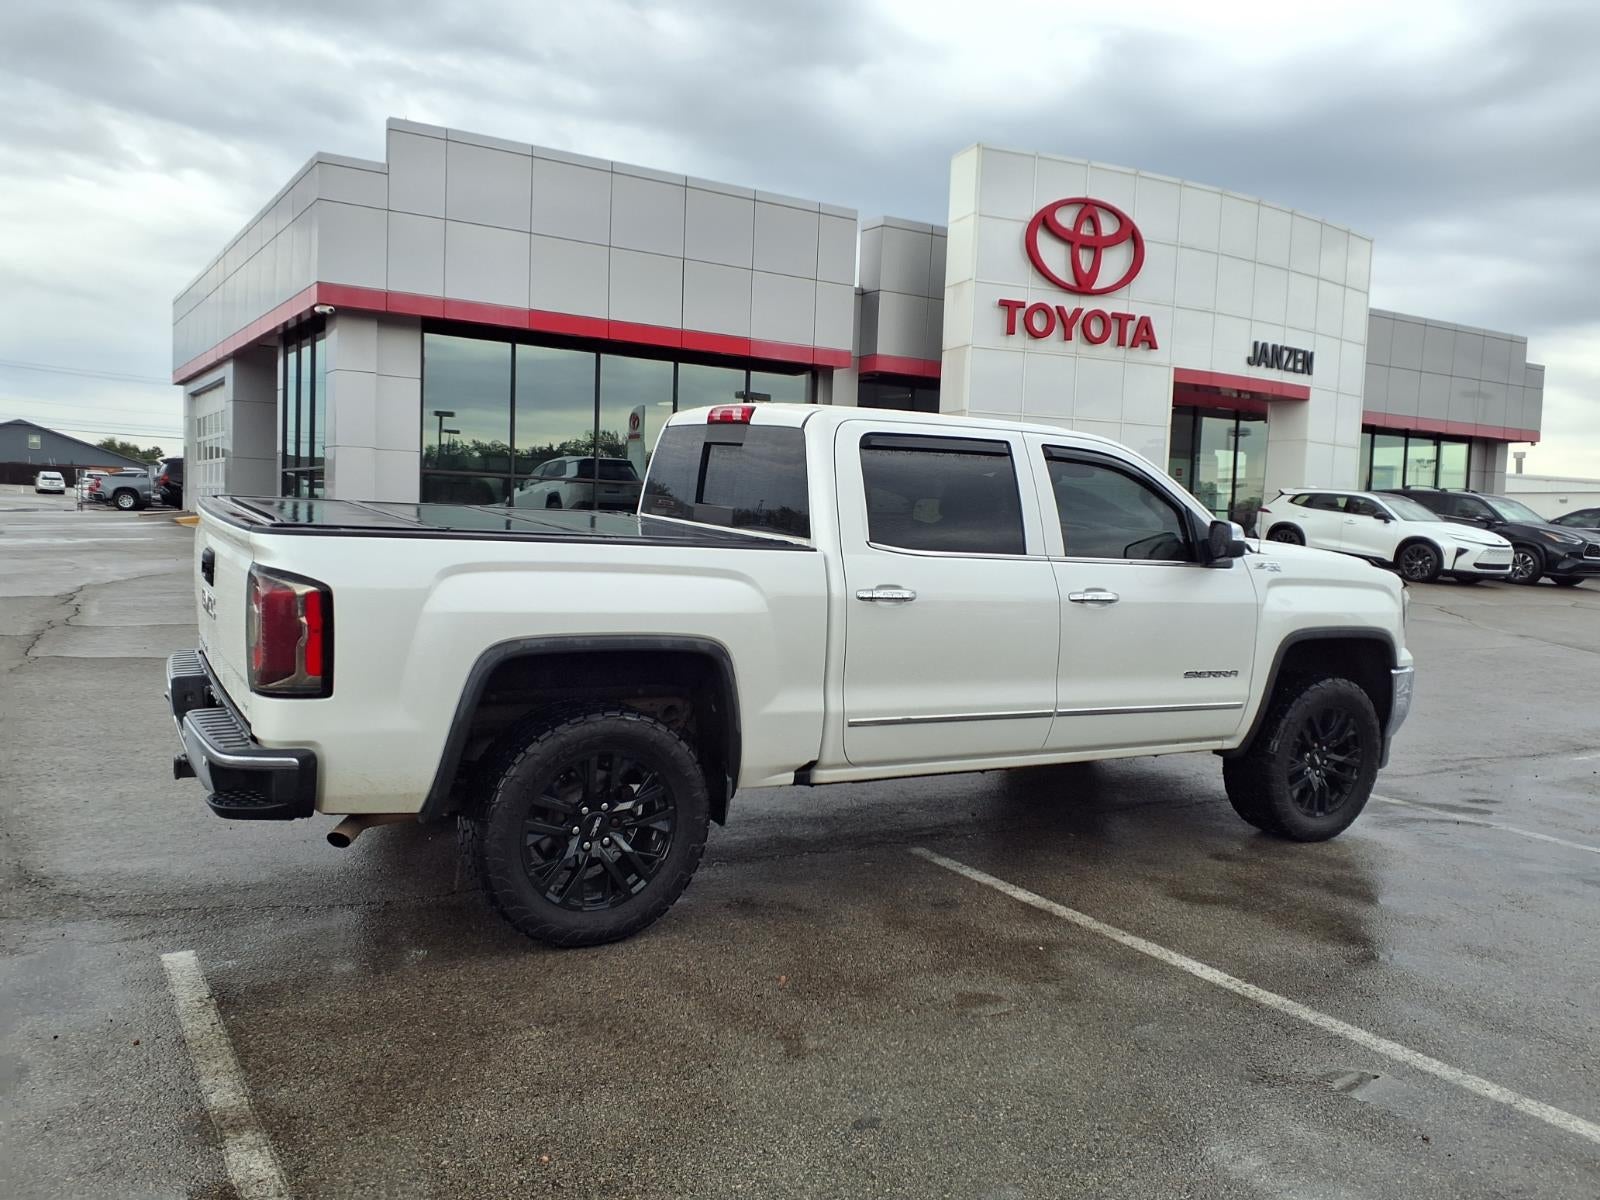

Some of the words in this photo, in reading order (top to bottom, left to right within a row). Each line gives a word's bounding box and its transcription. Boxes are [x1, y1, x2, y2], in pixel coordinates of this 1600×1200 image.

[998, 298, 1159, 350] TOYOTA
[1247, 340, 1315, 375] JANZEN
[1183, 670, 1239, 679] SIERRA
